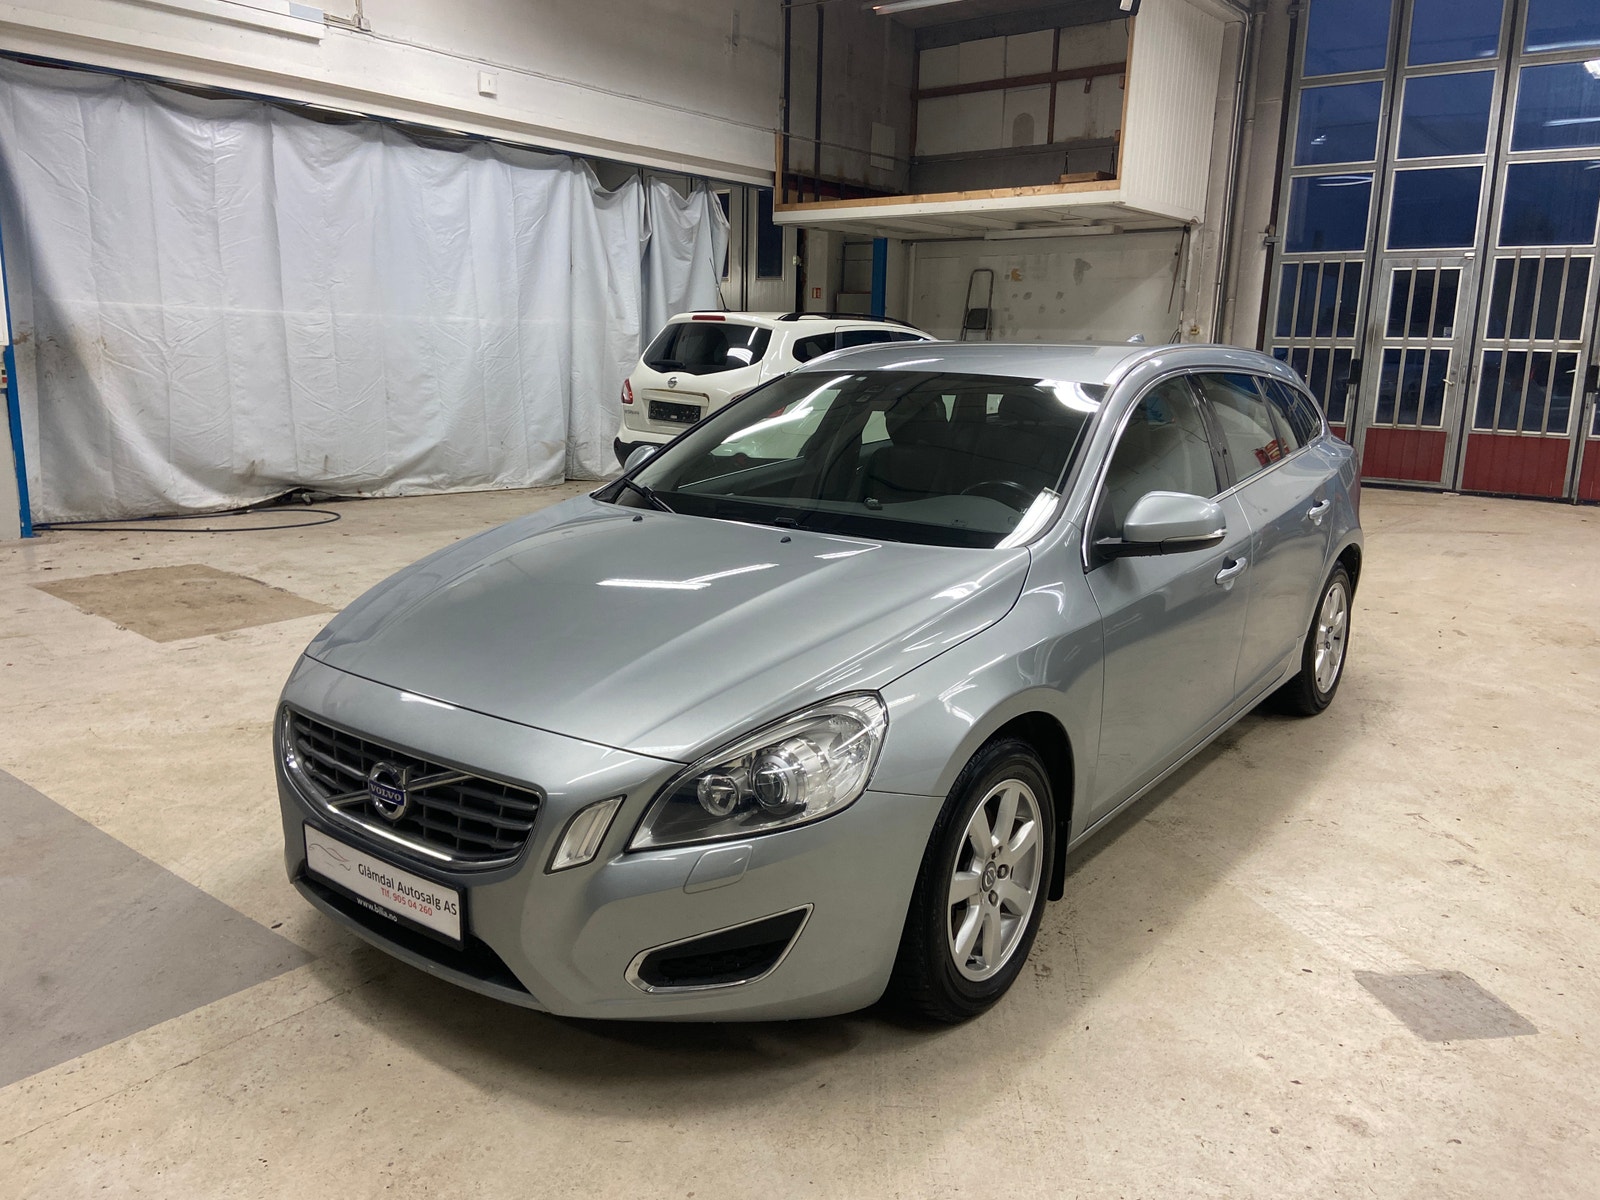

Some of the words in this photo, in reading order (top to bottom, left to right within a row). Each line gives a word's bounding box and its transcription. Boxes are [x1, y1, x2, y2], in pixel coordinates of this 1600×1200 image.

[370, 783, 402, 802] VOLVO
[392, 893, 407, 905] 905
[407, 899, 418, 910] 04
[419, 904, 433, 917] 260
[397, 881, 441, 911] Autosalg
[443, 900, 457, 916] AS
